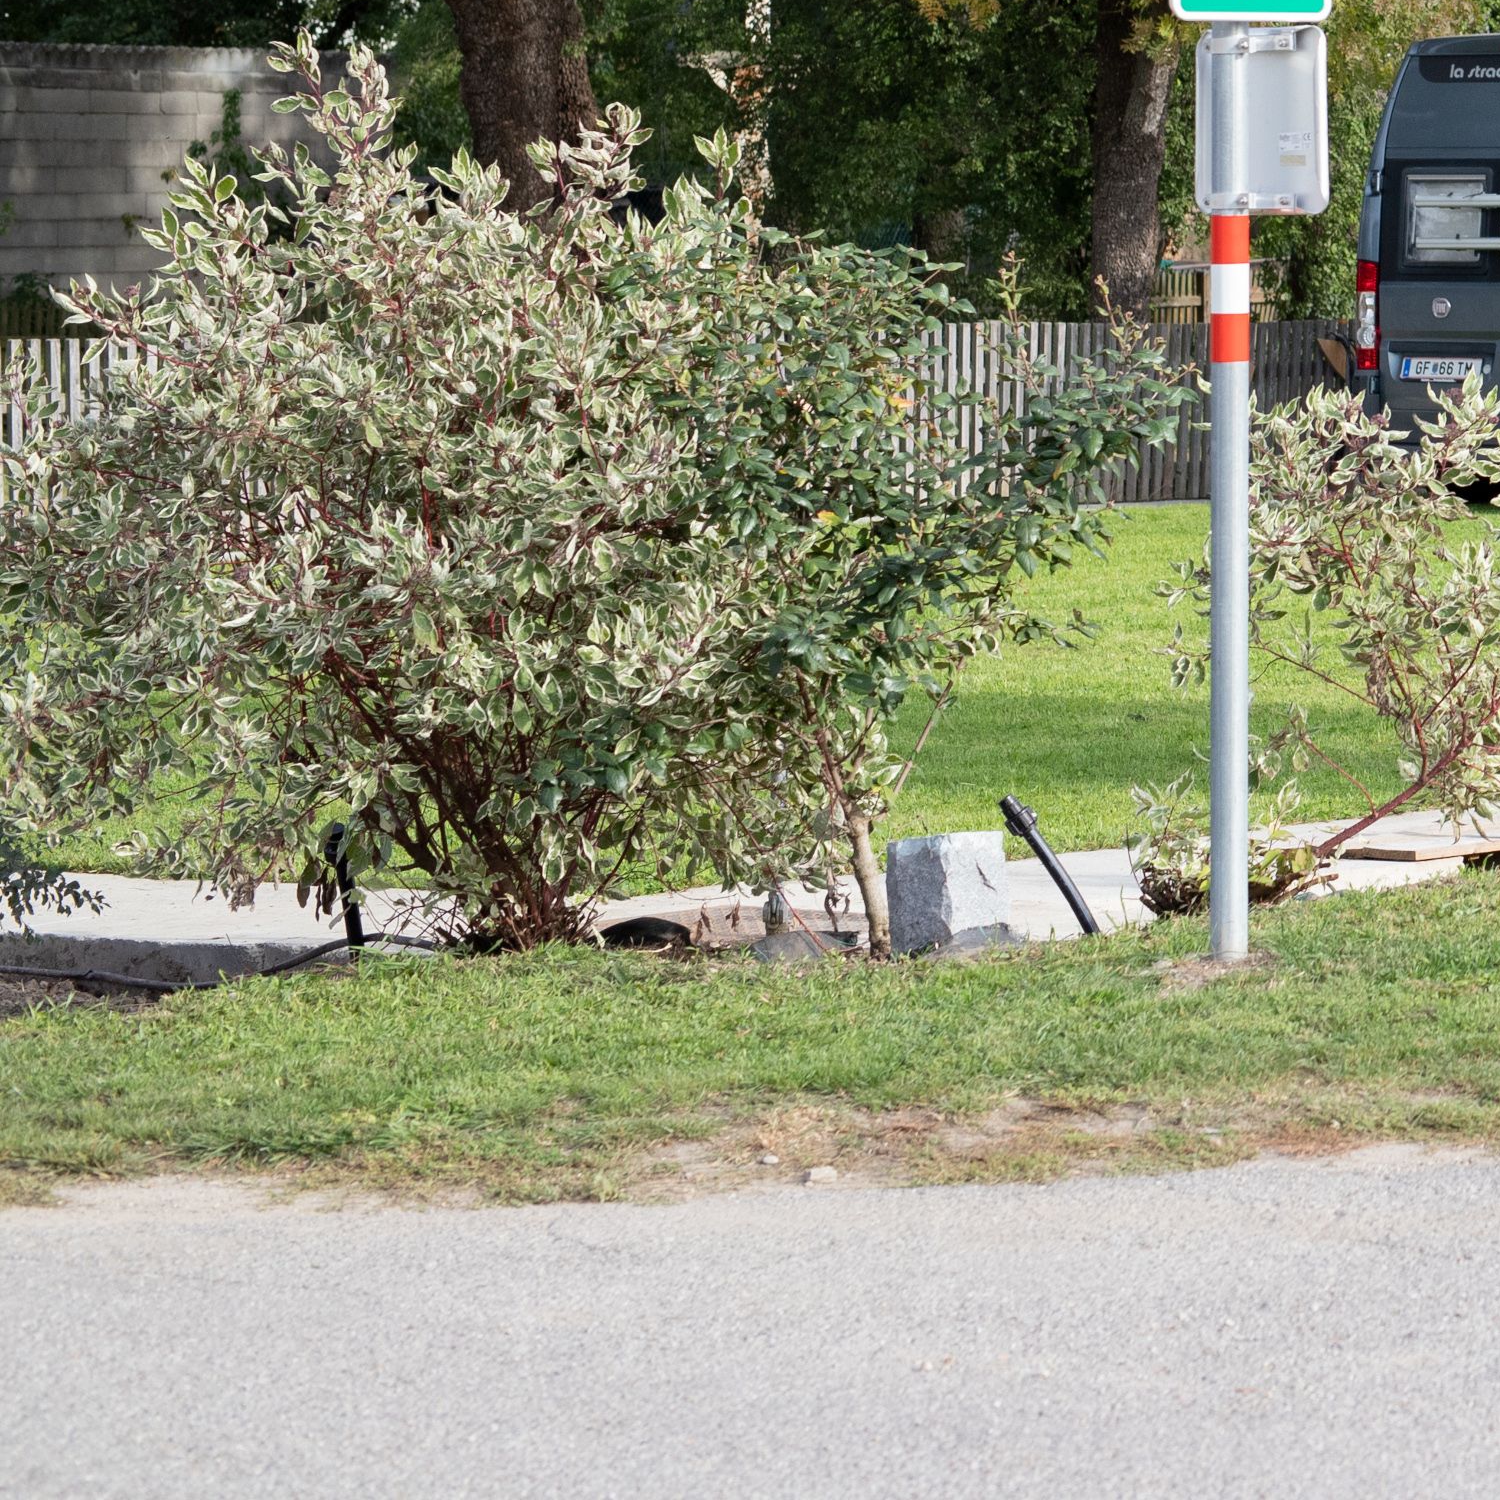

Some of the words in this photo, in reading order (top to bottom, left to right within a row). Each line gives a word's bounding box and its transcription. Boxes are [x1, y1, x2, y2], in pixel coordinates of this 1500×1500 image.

[1449, 63, 1465, 78] la
[1415, 361, 1431, 375] GF
[1439, 361, 1455, 375] 66
